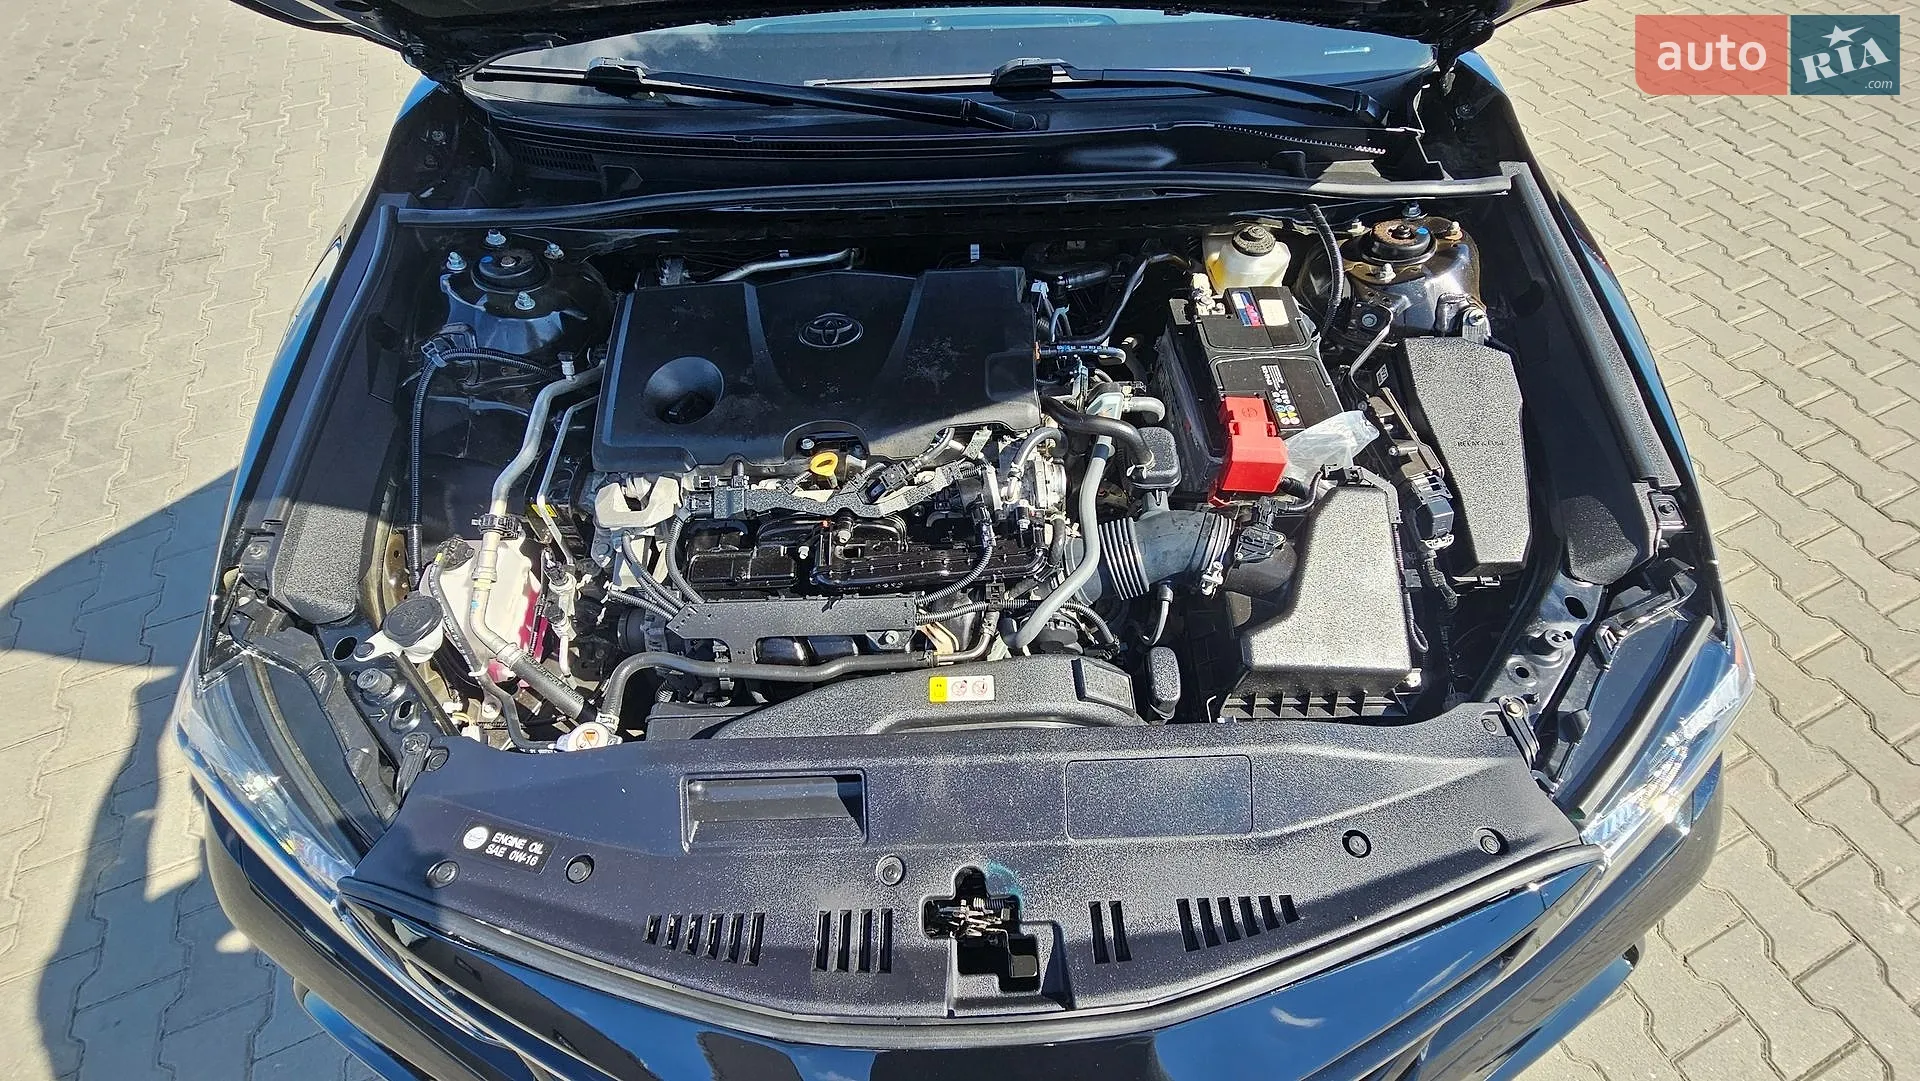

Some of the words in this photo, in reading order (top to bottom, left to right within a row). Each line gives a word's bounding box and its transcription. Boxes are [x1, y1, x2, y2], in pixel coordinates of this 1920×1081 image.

[485, 843, 507, 858] SAE
[492, 832, 528, 850] ENGINE
[528, 842, 544, 855] OIL
